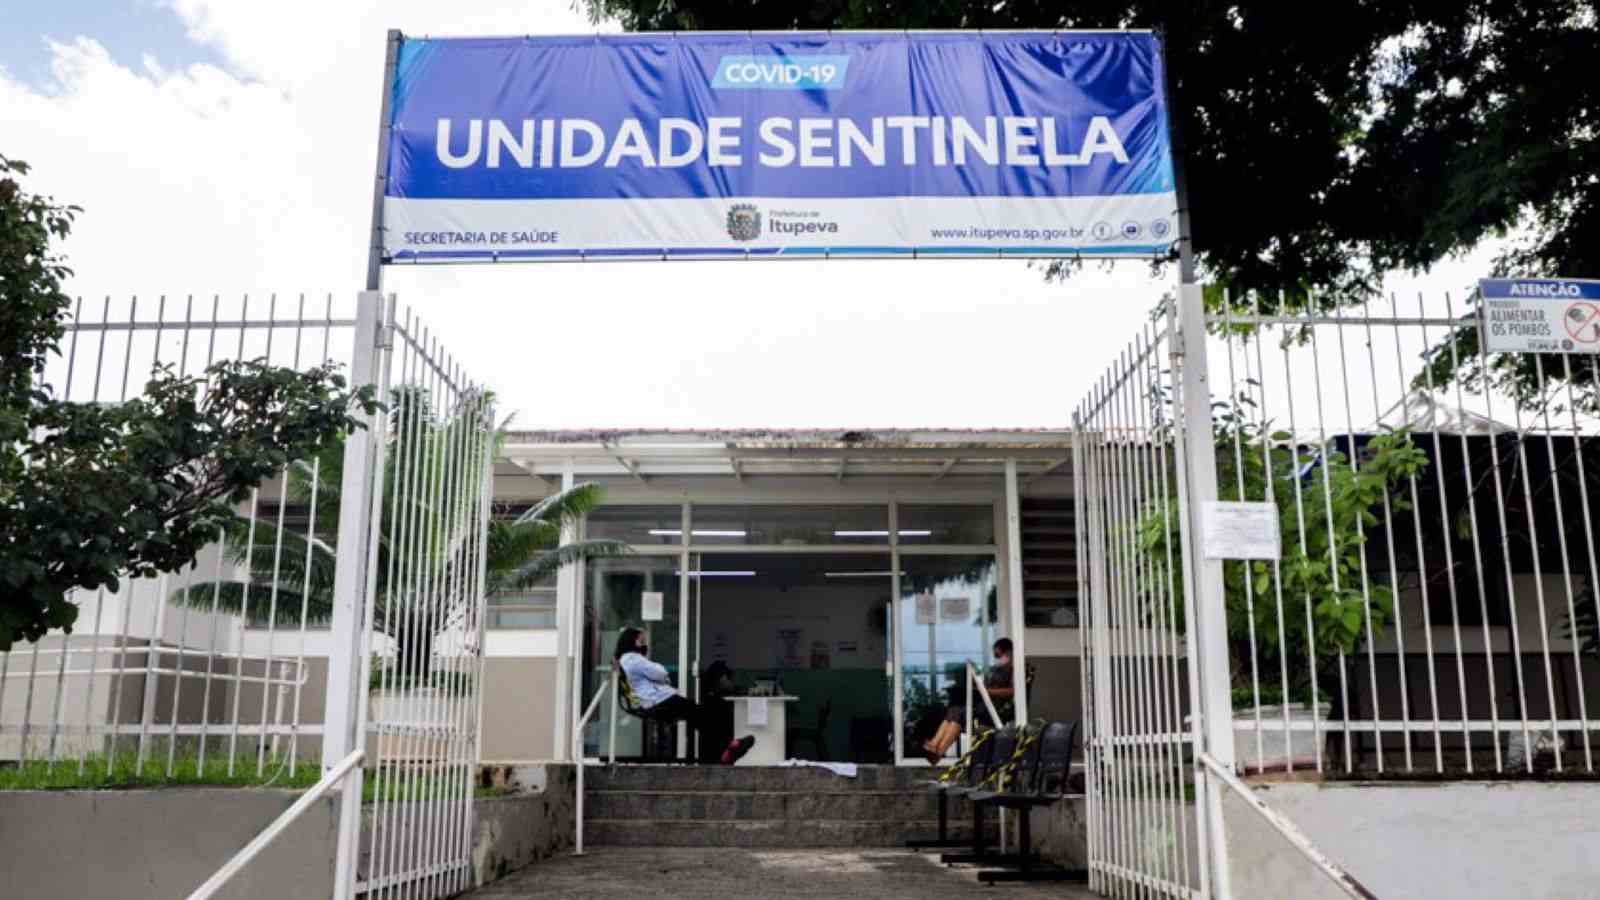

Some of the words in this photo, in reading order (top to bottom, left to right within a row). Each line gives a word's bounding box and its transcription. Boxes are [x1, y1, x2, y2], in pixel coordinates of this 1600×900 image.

[725, 63, 836, 84] COVID-19
[436, 117, 742, 168] UNIDADE
[758, 116, 1130, 168] SENTINELA
[769, 218, 838, 236] Itupeva
[930, 225, 1084, 240] www.itupeva.sp.gov.br
[403, 231, 486, 245] SECRETARIA
[490, 231, 507, 244] DE
[511, 229, 560, 243] SAÚDE
[1509, 281, 1581, 297] ATENÇÃO
[1490, 309, 1545, 321] ALIMENTAR
[1491, 323, 1506, 336] OS
[1508, 323, 1551, 336] POMBOS
